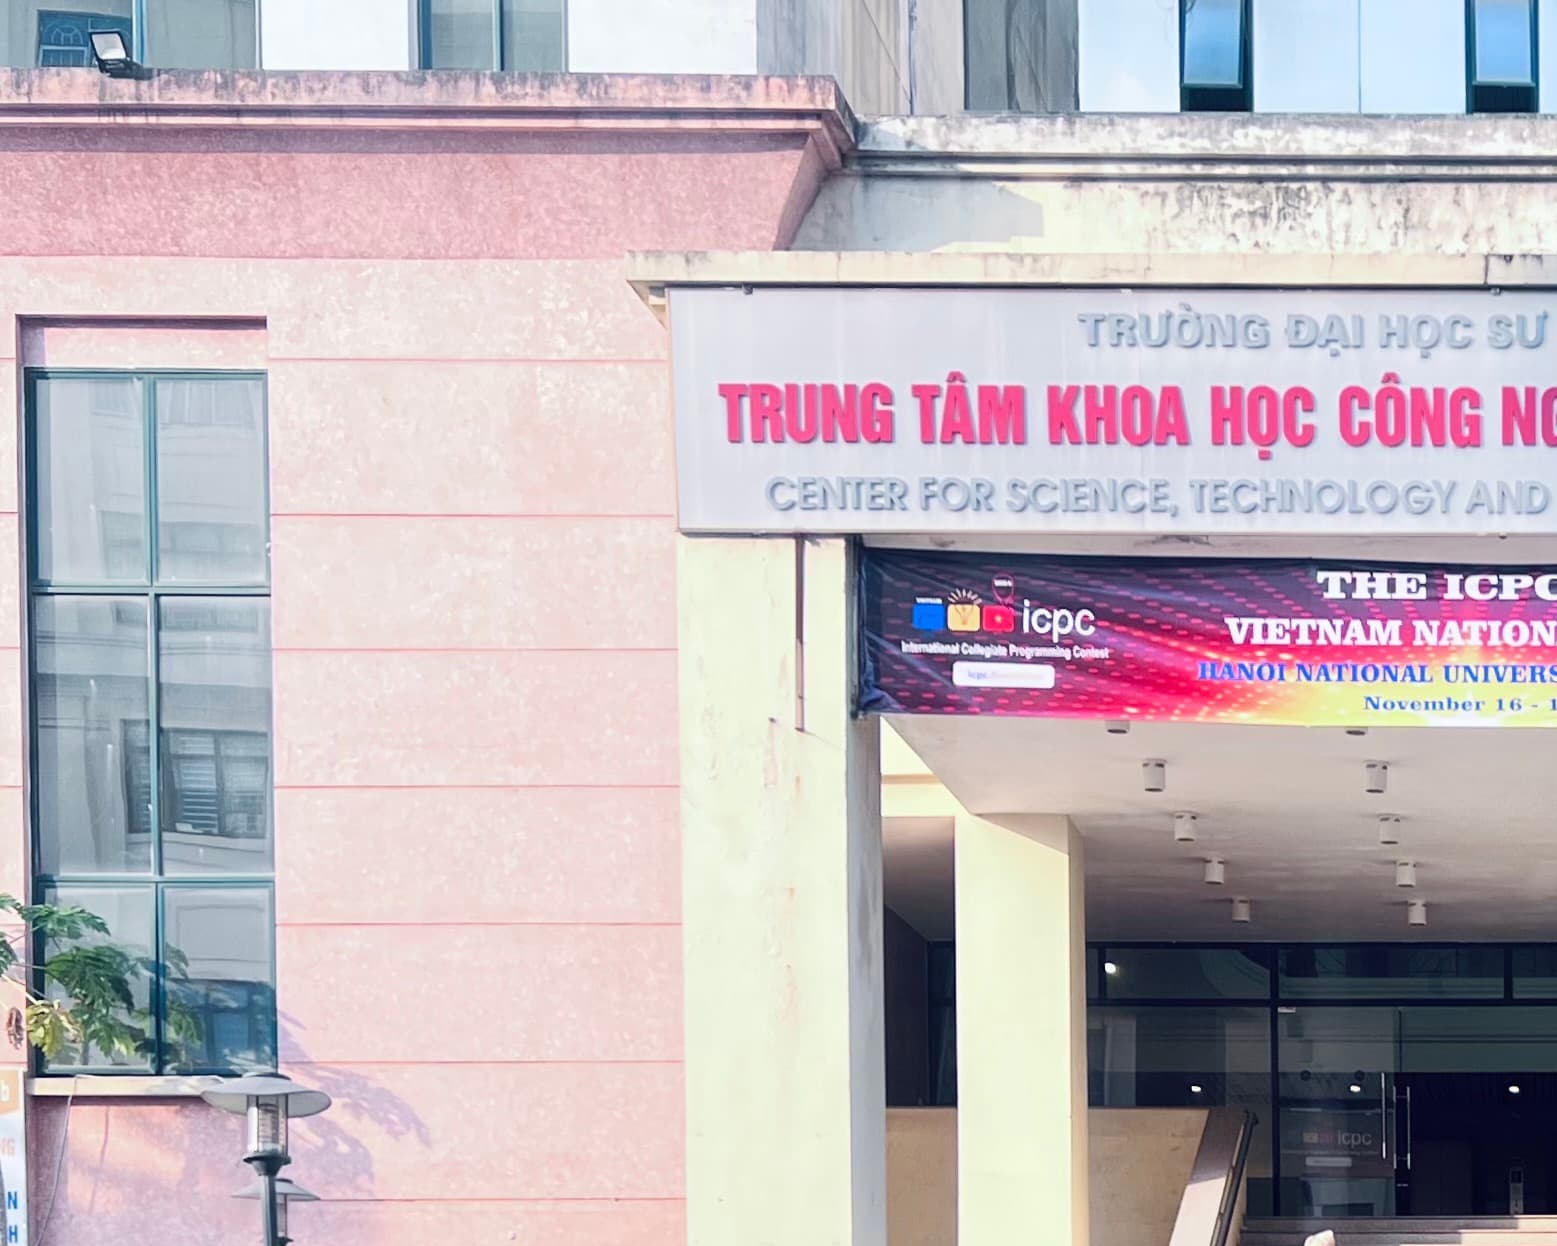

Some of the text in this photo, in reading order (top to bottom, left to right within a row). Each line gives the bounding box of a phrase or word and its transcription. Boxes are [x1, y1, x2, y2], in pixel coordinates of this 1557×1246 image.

[1078, 302, 1270, 350] TRƯỜNG
[1285, 312, 1364, 358] ĐẠI
[1378, 313, 1474, 359] HỌC
[1487, 309, 1549, 350] SƯ
[717, 382, 895, 446] TRUNG
[912, 370, 1026, 447] TÂM
[1047, 383, 1191, 448] KHOA
[1211, 385, 1316, 461] HỌC
[1339, 371, 1483, 448] CÔNG
[765, 476, 909, 512] CENTER
[919, 477, 996, 512] FOR
[1006, 478, 1180, 518] SCIENCE,
[1189, 479, 1457, 516] TECHNOLOGY
[1464, 479, 1552, 516] AND
[1317, 571, 1427, 600] THE
[1023, 598, 1096, 643] icpc
[1224, 617, 1403, 645] VIETNAM
[1198, 662, 1287, 682] HANOI
[1296, 663, 1434, 683] NATIONAL
[1363, 695, 1486, 712] November
[1497, 697, 1523, 712] 16
